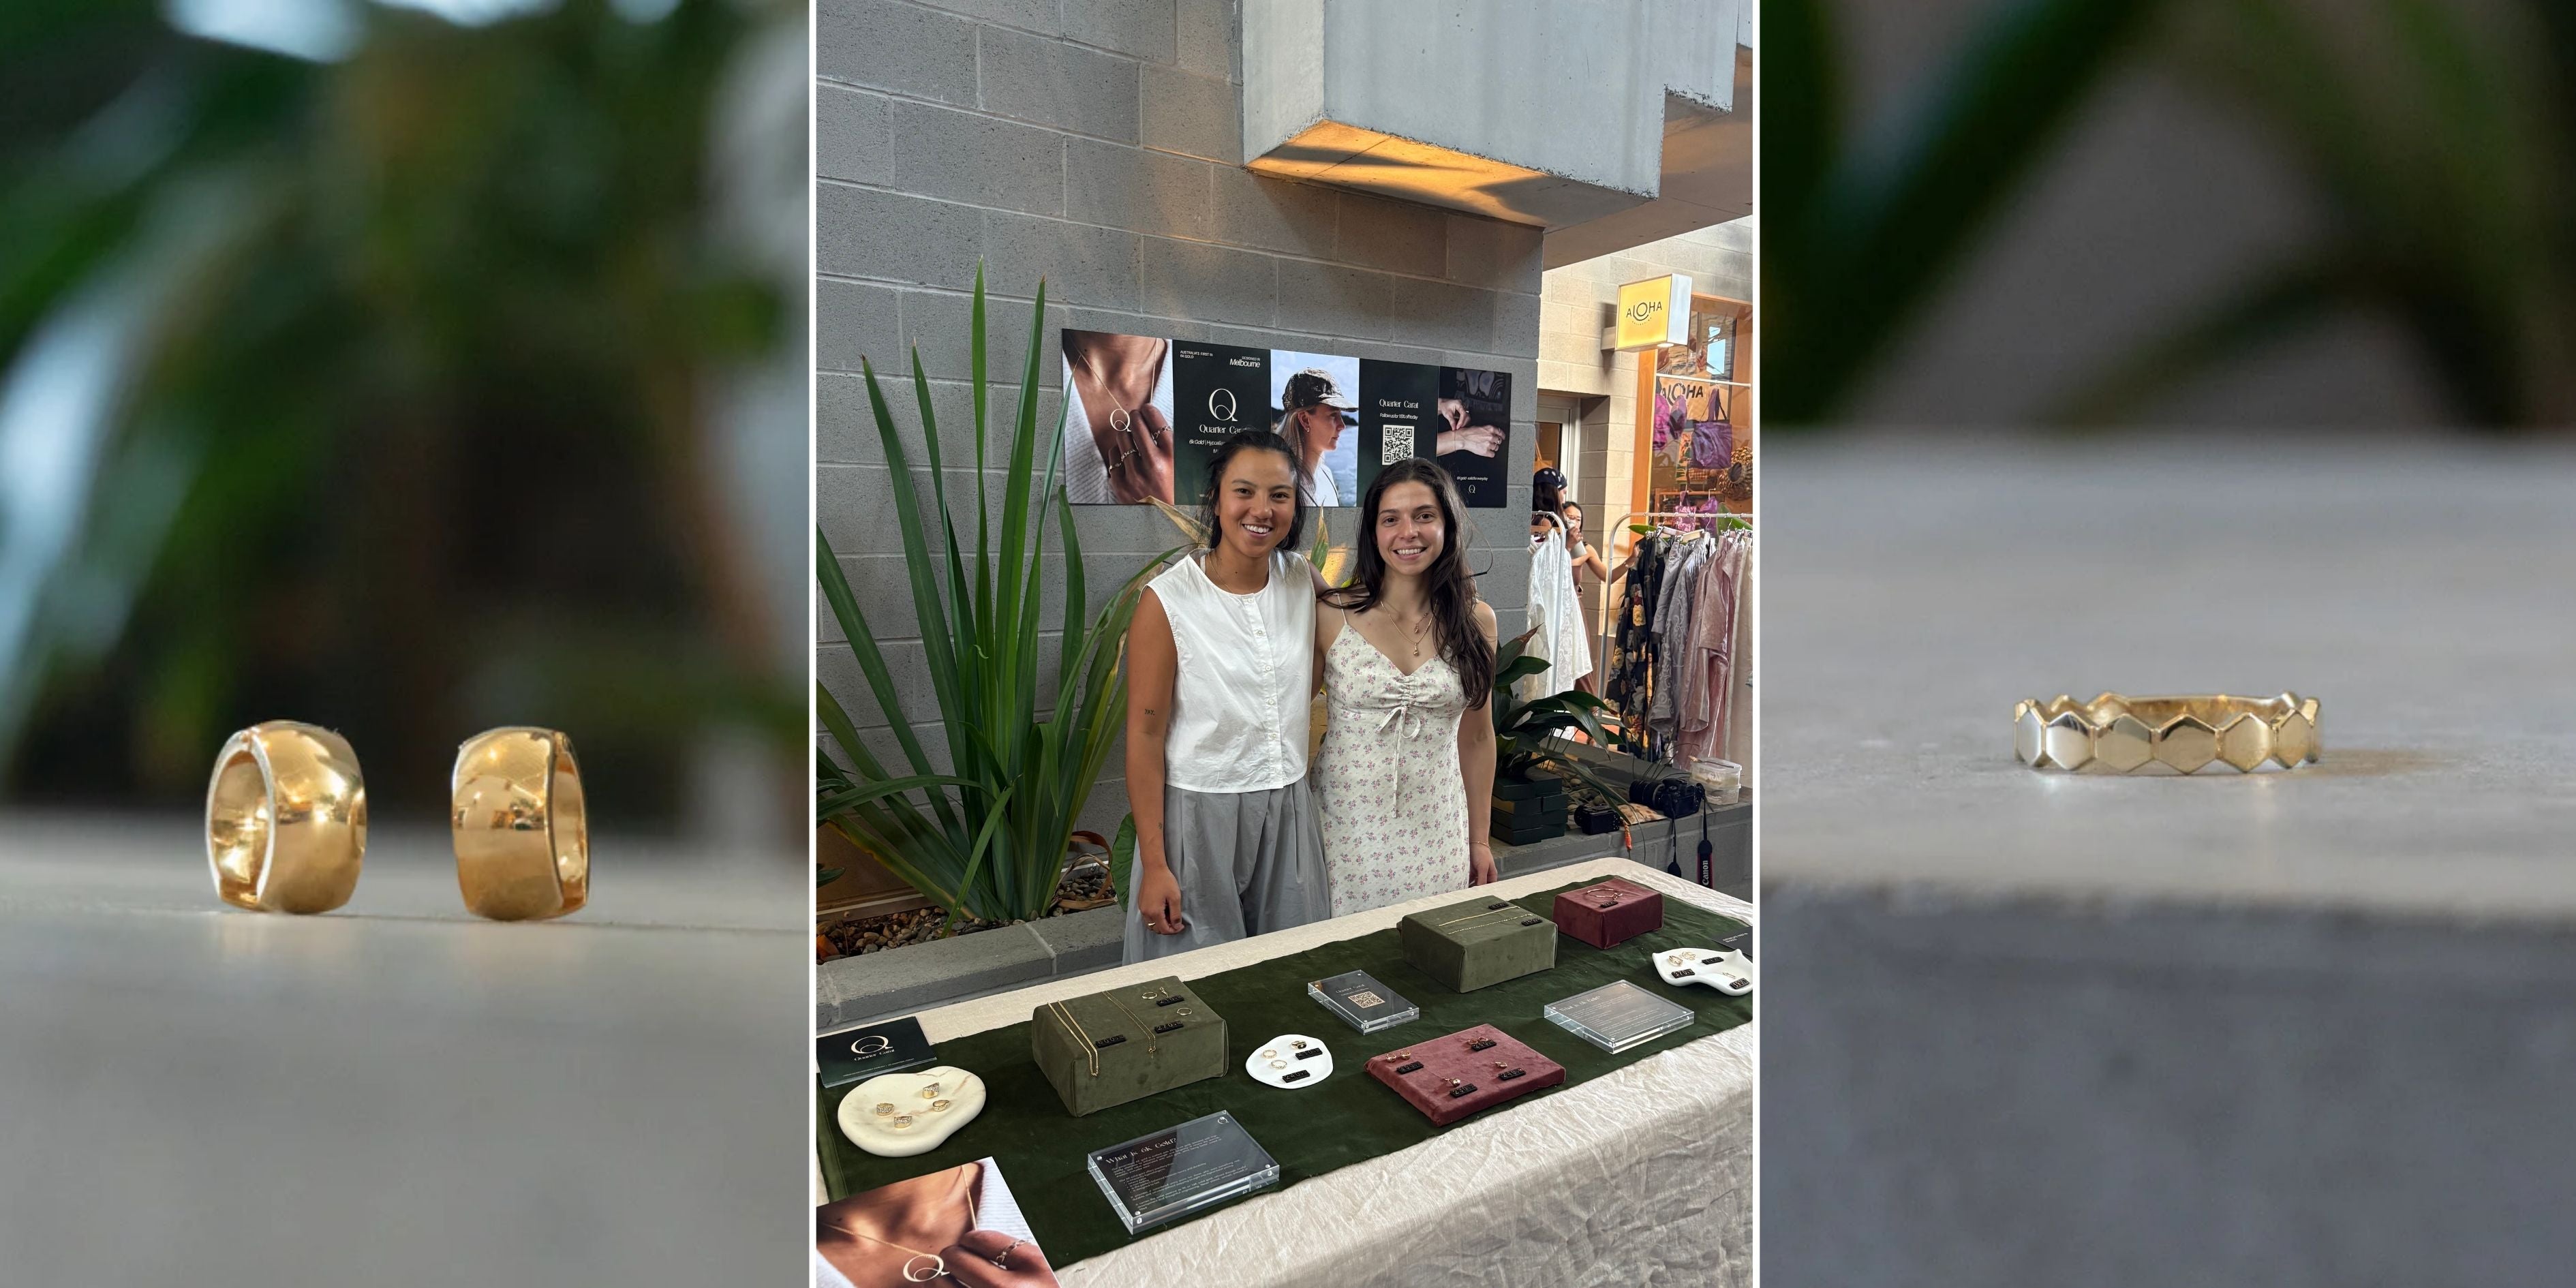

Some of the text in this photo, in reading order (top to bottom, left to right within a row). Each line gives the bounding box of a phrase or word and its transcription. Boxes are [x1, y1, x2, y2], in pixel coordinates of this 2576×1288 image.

[1627, 301, 1662, 321] ALOHA
[1229, 358, 1261, 368] Melbourne
[1209, 388, 1238, 421] Q
[1379, 399, 1418, 409] Quarter Carat
[1199, 425, 1227, 433] Quarter
[851, 1035, 893, 1054] Q
[1105, 1154, 1128, 1164] What
[1154, 1137, 1176, 1148] Gold?
